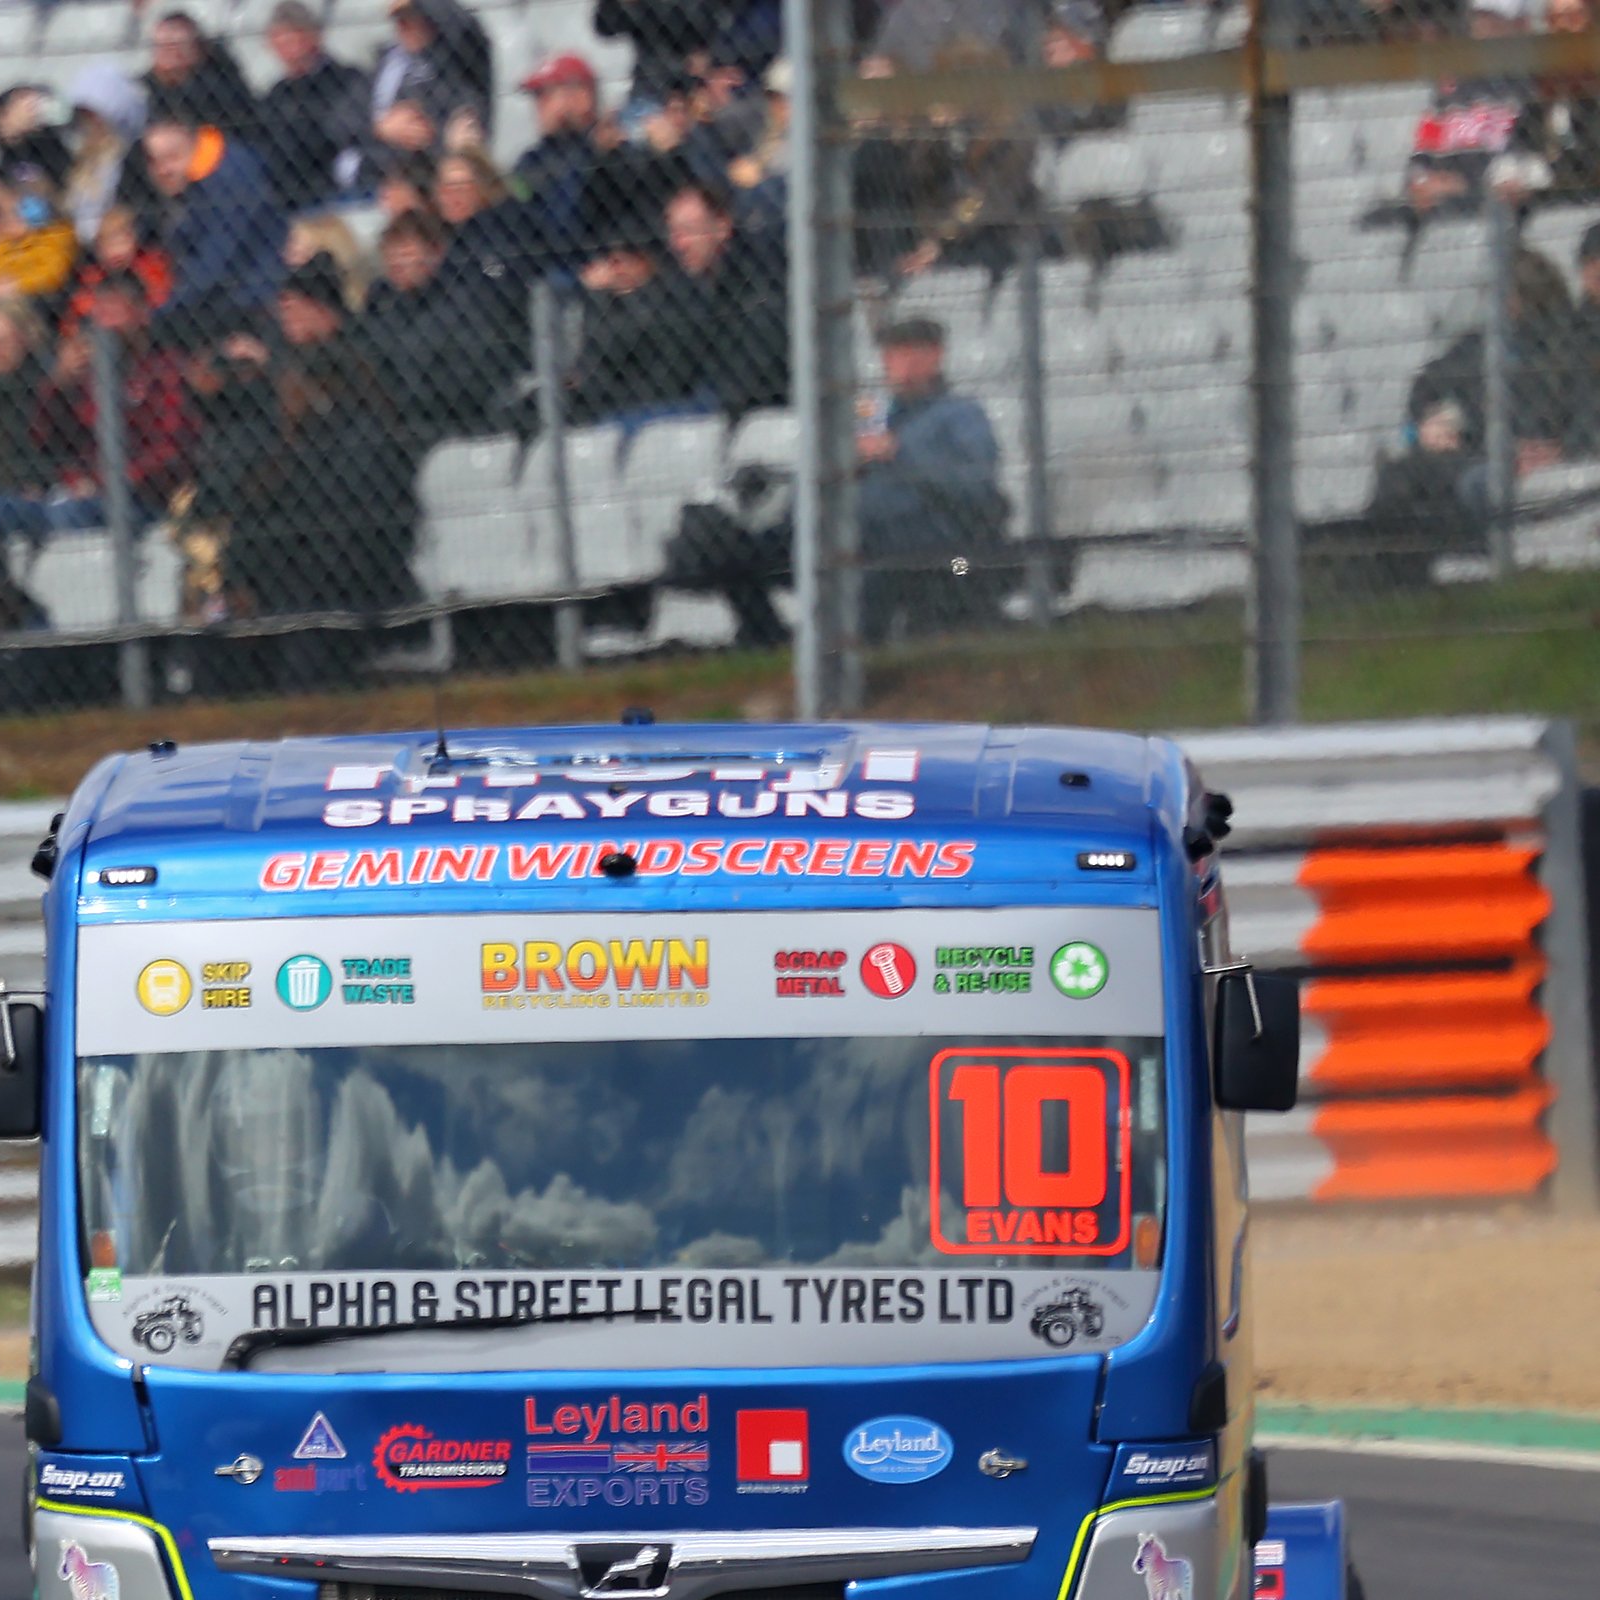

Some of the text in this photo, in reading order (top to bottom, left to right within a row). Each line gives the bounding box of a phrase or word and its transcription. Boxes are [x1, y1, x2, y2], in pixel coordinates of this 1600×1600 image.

[323, 789, 917, 829] SPRAYGUNS
[259, 838, 977, 893] GEMINI WINDSCREENS
[340, 957, 413, 980] TRADE
[480, 938, 710, 993] BROWN
[774, 950, 849, 973] SCRAP
[934, 946, 1036, 969] RECYCLE
[202, 961, 252, 985] SKIP
[933, 973, 951, 994] &
[341, 983, 415, 1006] WASTE
[776, 976, 846, 997] METAL
[202, 988, 253, 1010] HIRE
[482, 992, 710, 1011] RECYCLING LIMITED
[948, 1065, 1108, 1209] 10
[966, 1210, 1099, 1245] EVANS
[253, 1277, 1014, 1329] ALPHA & STREET LEGAL TYRES LTD
[524, 1393, 710, 1445] Leyland
[389, 1439, 512, 1462] GARDNER
[853, 1427, 943, 1462] Leyland
[397, 1461, 509, 1479] TRANSMISSIONS
[525, 1477, 710, 1508] EXPORTS
